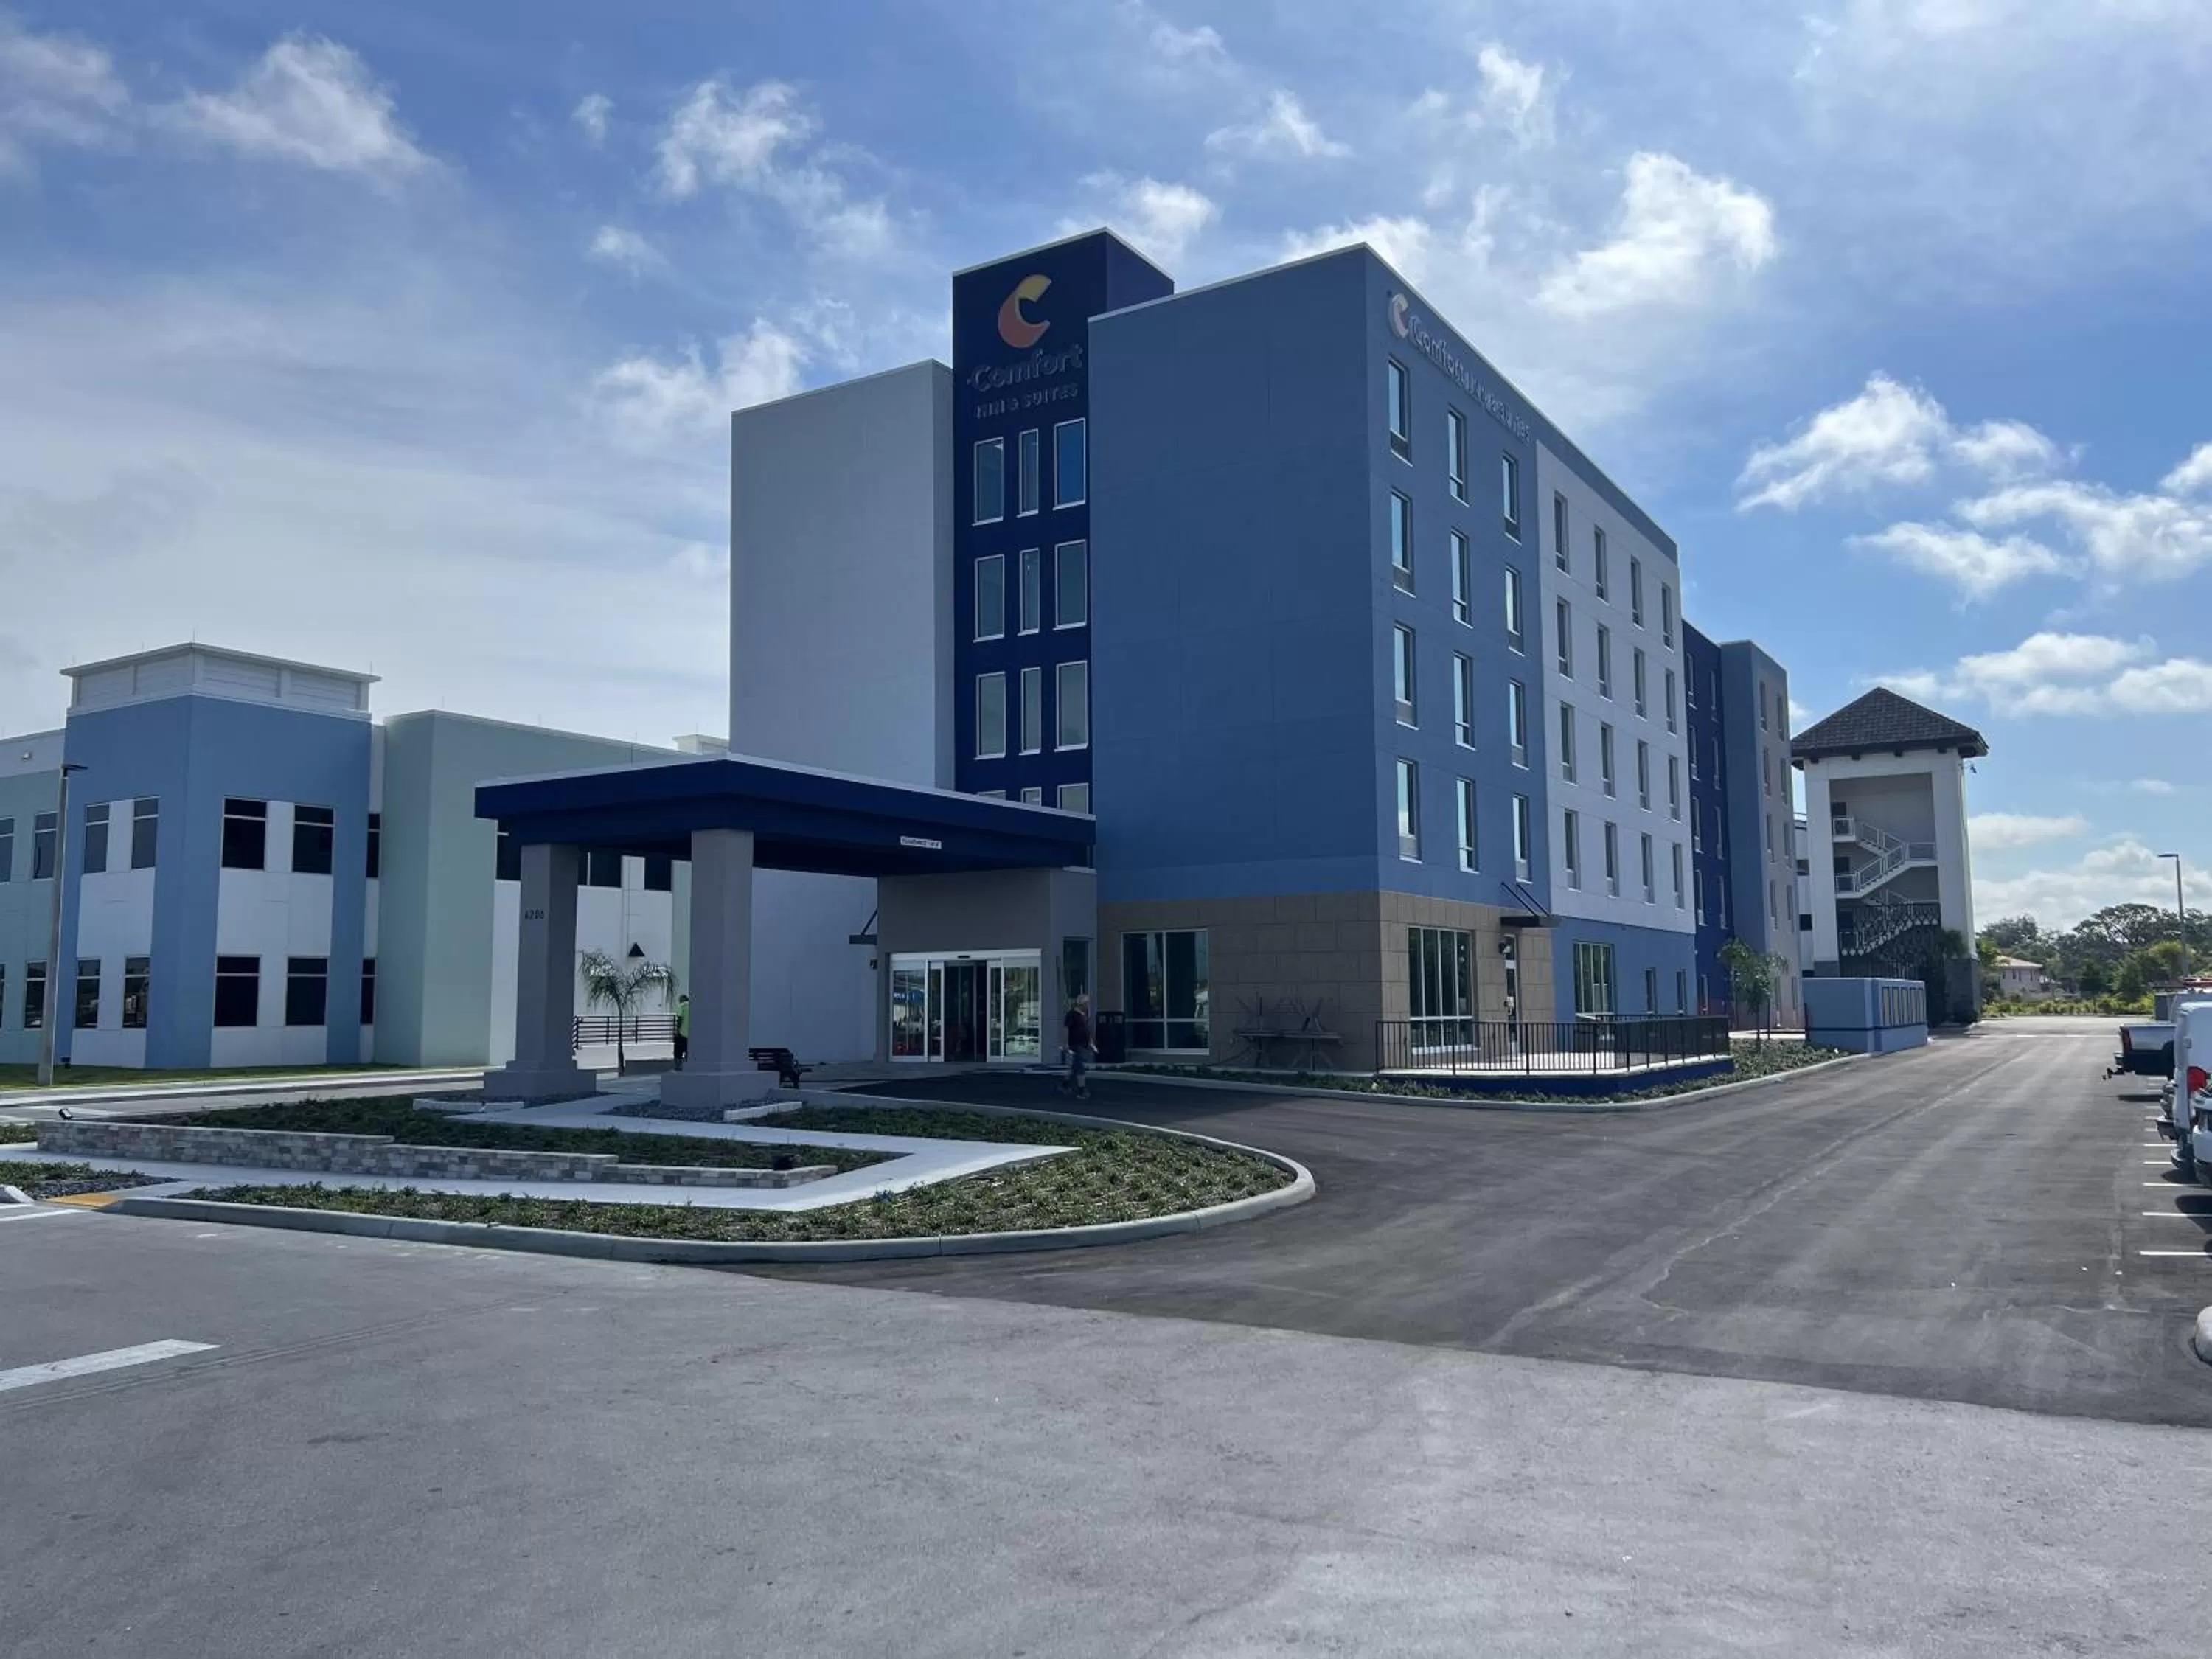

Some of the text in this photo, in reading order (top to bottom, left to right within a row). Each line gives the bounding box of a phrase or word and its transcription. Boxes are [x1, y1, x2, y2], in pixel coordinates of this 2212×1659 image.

[969, 344, 1084, 392] Comfort
[975, 399, 1006, 419] INN
[1026, 383, 1079, 406] SUITES
